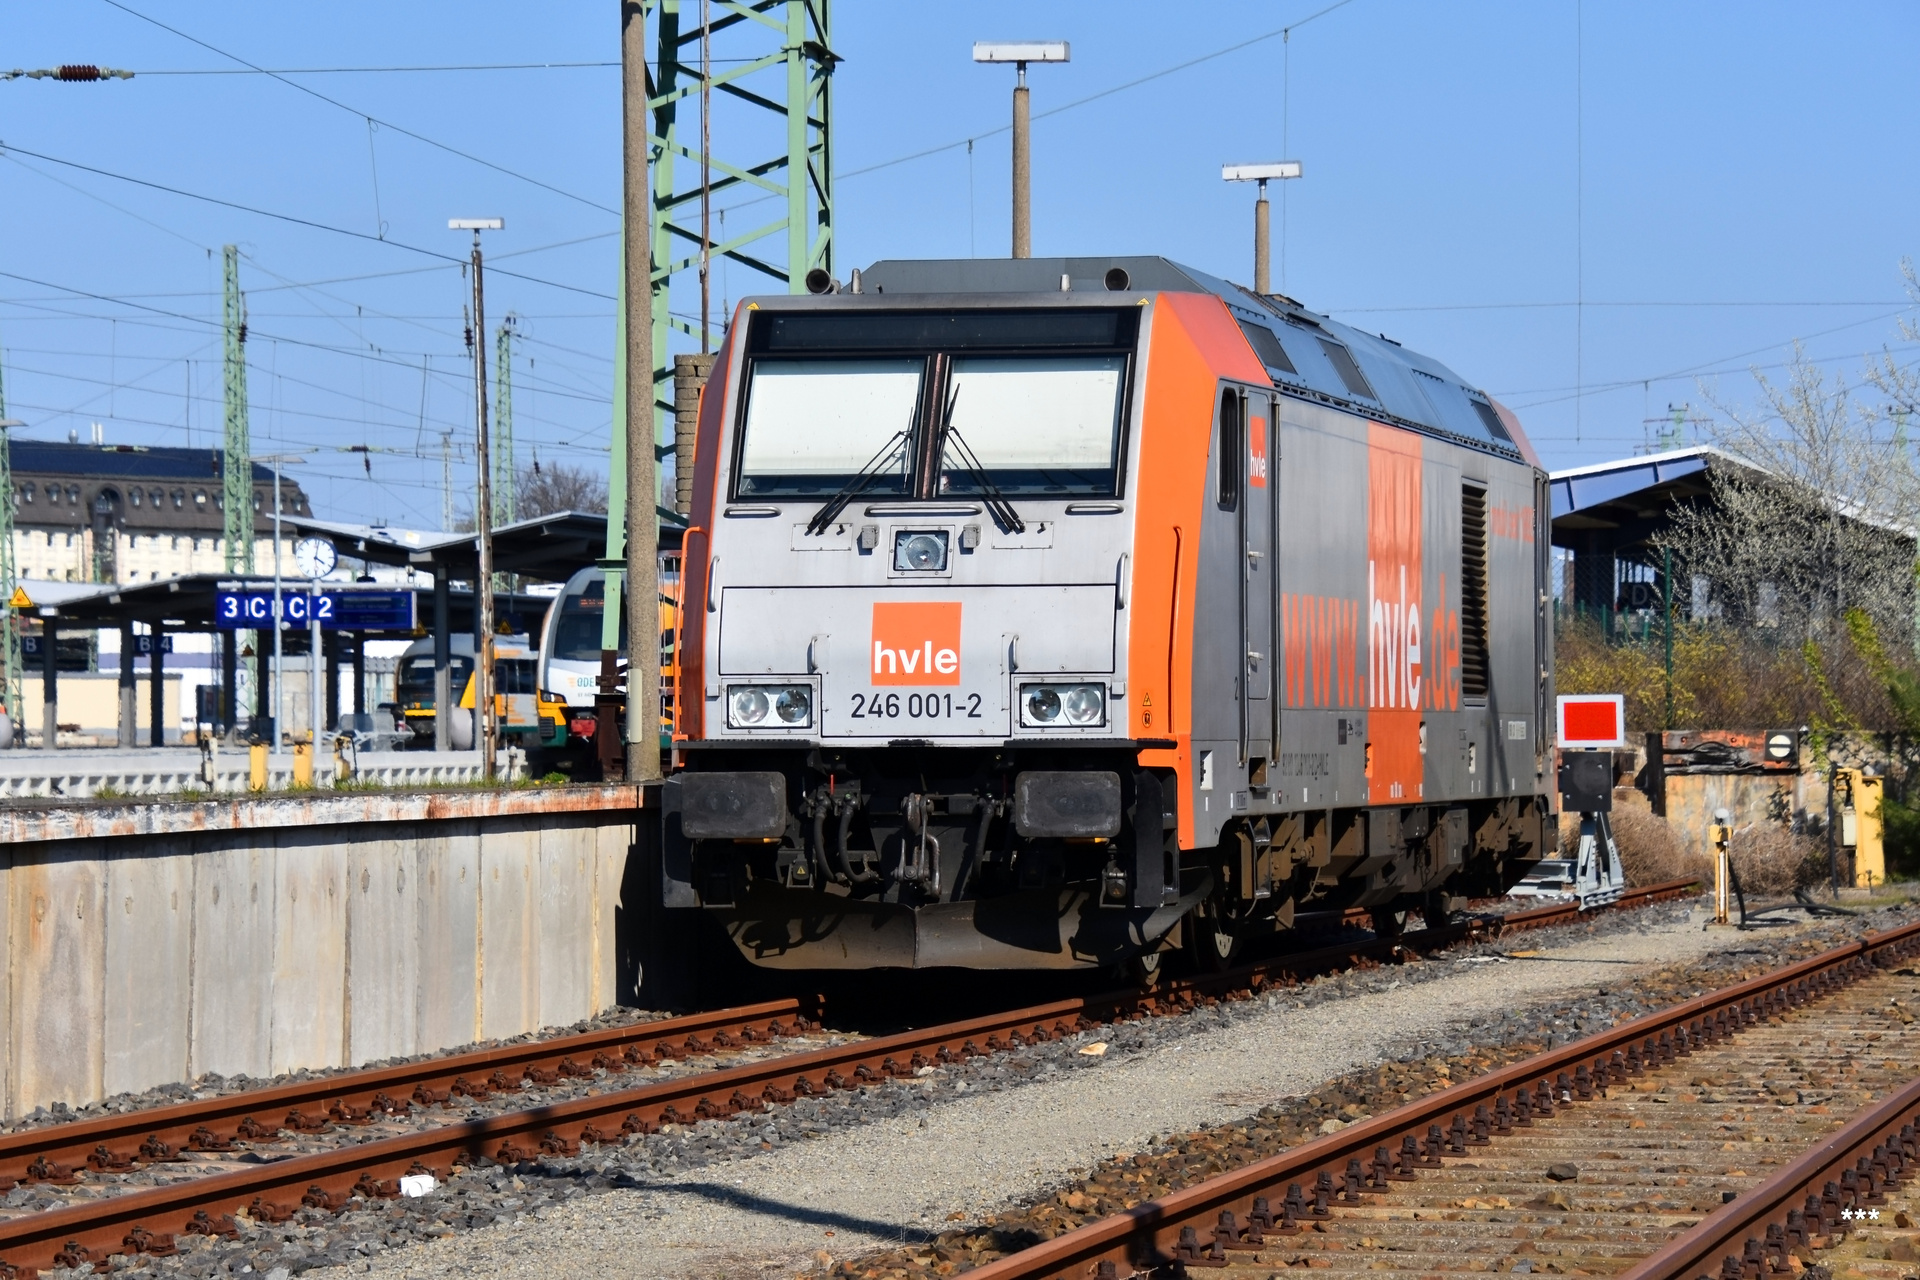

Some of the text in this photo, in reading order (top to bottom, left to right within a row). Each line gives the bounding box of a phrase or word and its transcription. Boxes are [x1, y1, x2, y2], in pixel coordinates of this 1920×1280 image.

[1250, 449, 1266, 478] hvle
[224, 597, 332, 618] 3 C C 2
[26, 637, 37, 652] B
[139, 637, 171, 652] B 4
[874, 640, 958, 674] hvle
[577, 677, 595, 688] ODE
[851, 693, 982, 718] 246 001-2
